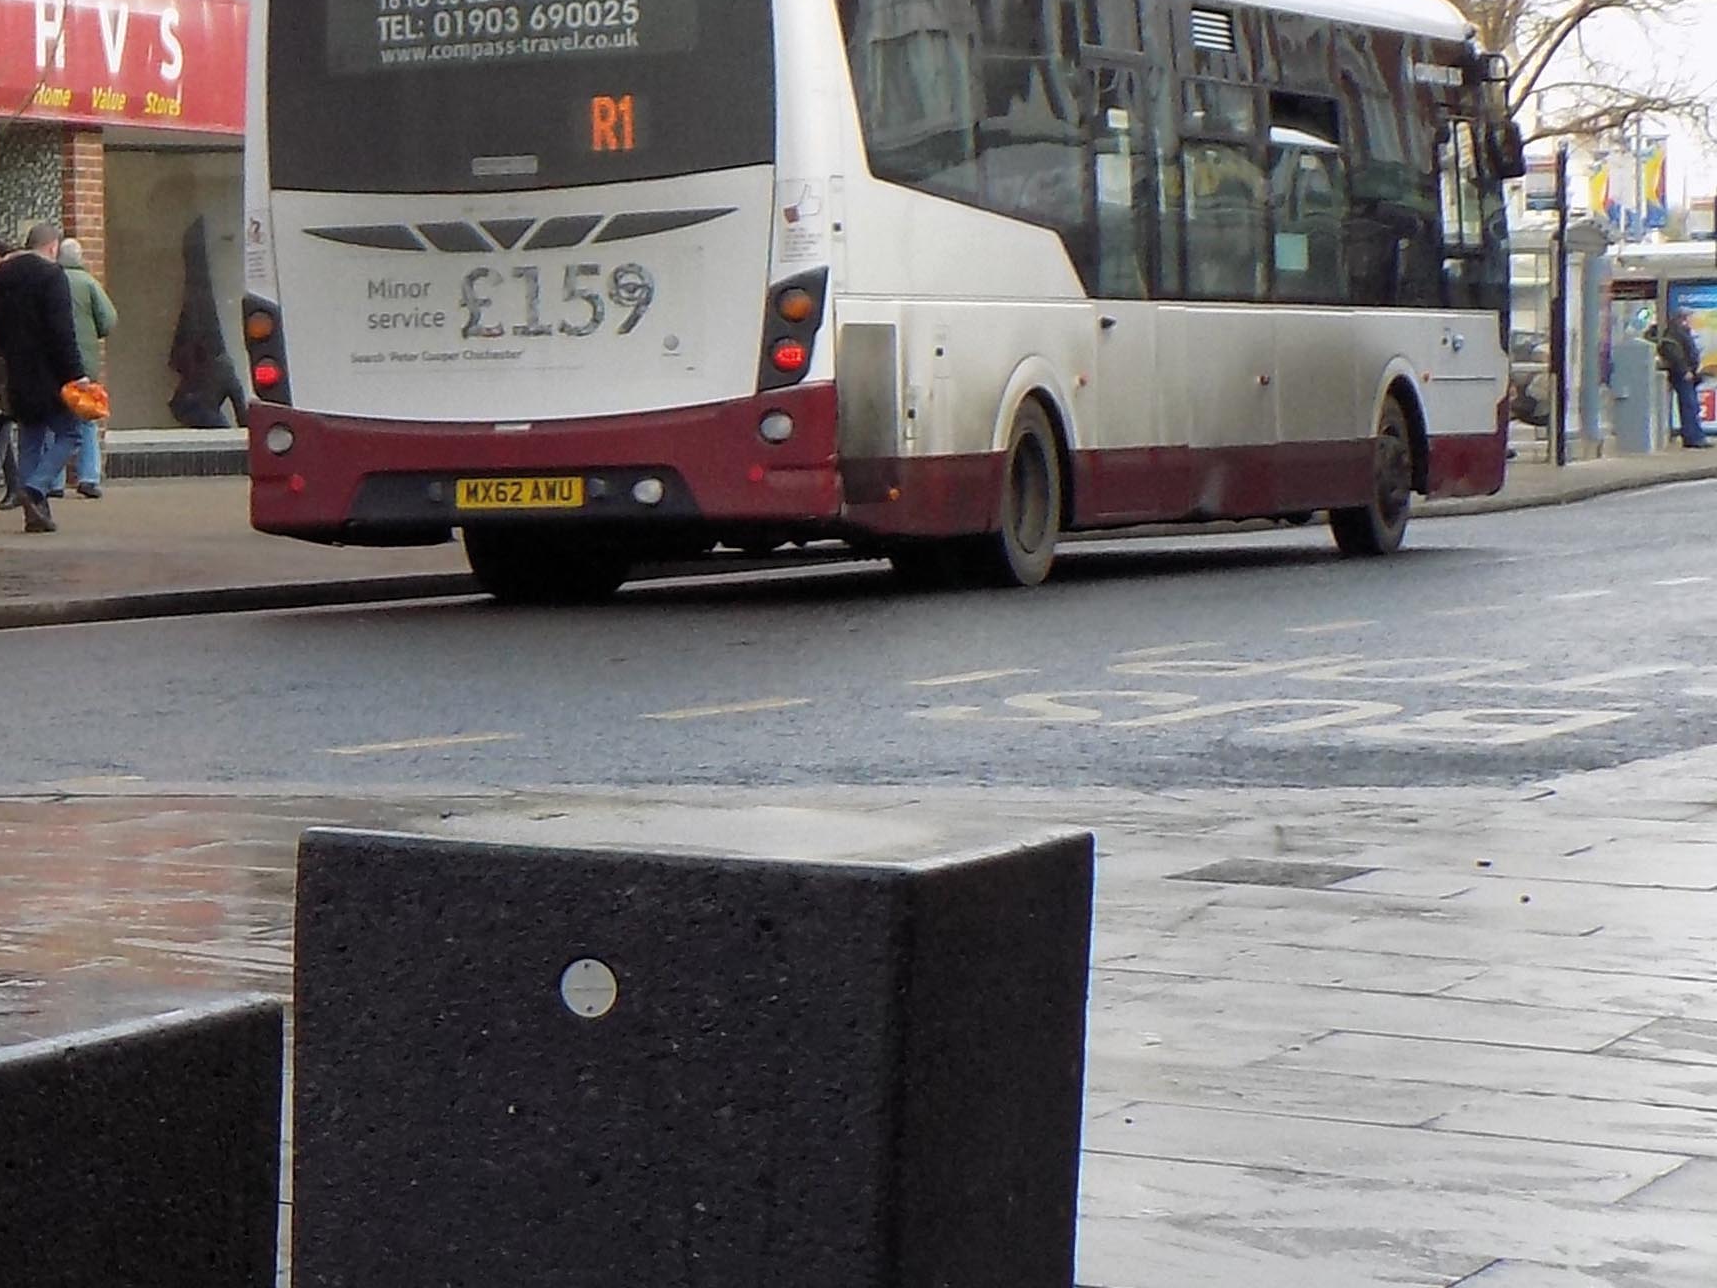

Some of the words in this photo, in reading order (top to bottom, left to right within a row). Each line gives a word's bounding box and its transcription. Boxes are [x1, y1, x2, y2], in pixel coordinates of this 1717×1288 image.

[376, 15, 426, 42] TEL:
[432, 7, 520, 38] 01903
[528, 0, 640, 31] 690025
[379, 28, 640, 64] www.compass-travel.co.uk
[33, 83, 73, 108] Home
[91, 86, 127, 111] Value
[144, 91, 183, 116] Stores
[590, 93, 635, 151] R1
[367, 279, 432, 299] Minor
[459, 262, 655, 340] £159
[367, 307, 446, 330] service
[466, 480, 524, 503] MX62
[530, 479, 573, 502] AWU
